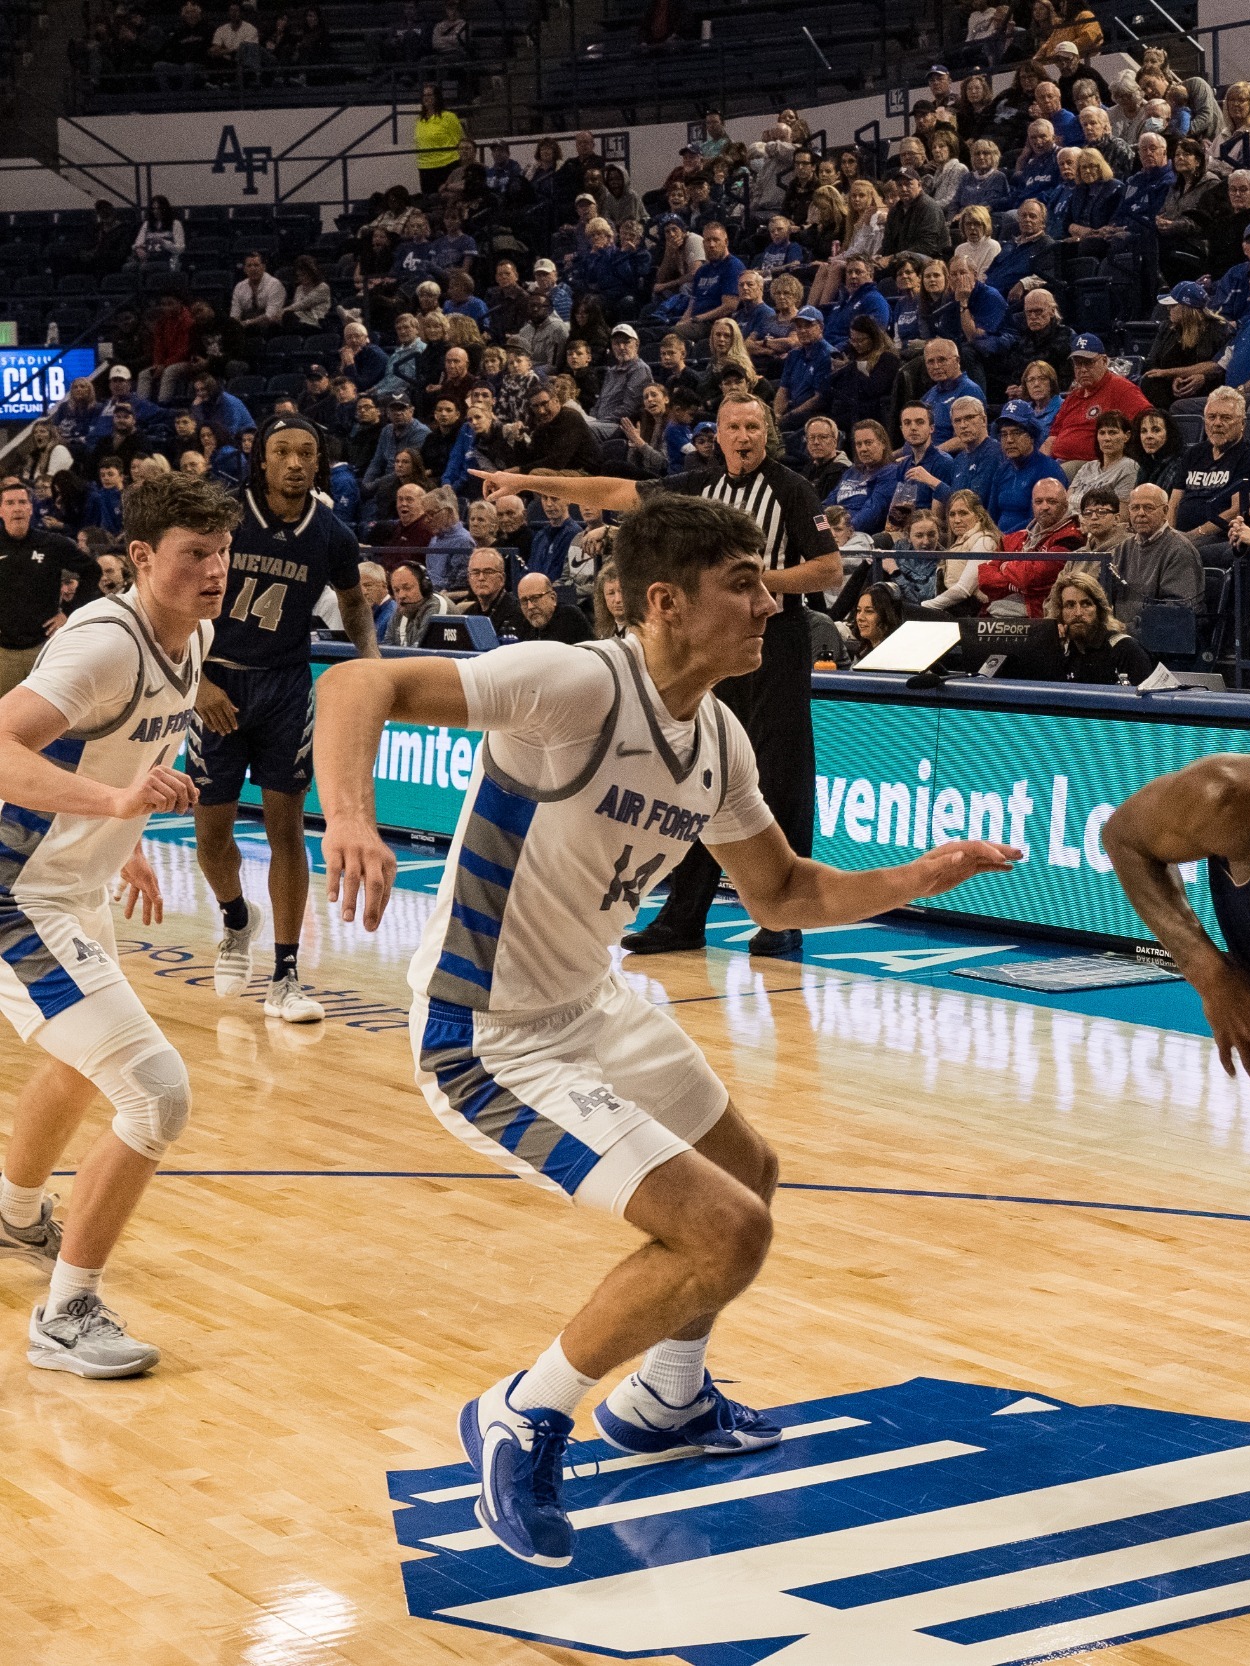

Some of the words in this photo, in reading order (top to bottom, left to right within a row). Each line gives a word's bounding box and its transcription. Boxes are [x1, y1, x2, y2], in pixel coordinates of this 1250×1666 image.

[212, 125, 272, 195] AF
[1076, 336, 1089, 349] AF
[1006, 402, 1018, 414] AF
[1185, 470, 1230, 487] NEVADA
[31, 550, 46, 564] AF
[231, 552, 309, 583] NEVADA
[229, 577, 288, 632] 14
[444, 628, 457, 642] POSS
[128, 713, 164, 743] AIR
[372, 719, 483, 791] imite
[594, 783, 646, 828] AIR
[642, 800, 709, 843] FORCE
[72, 937, 109, 964] AF
[568, 1086, 621, 1118] AF
